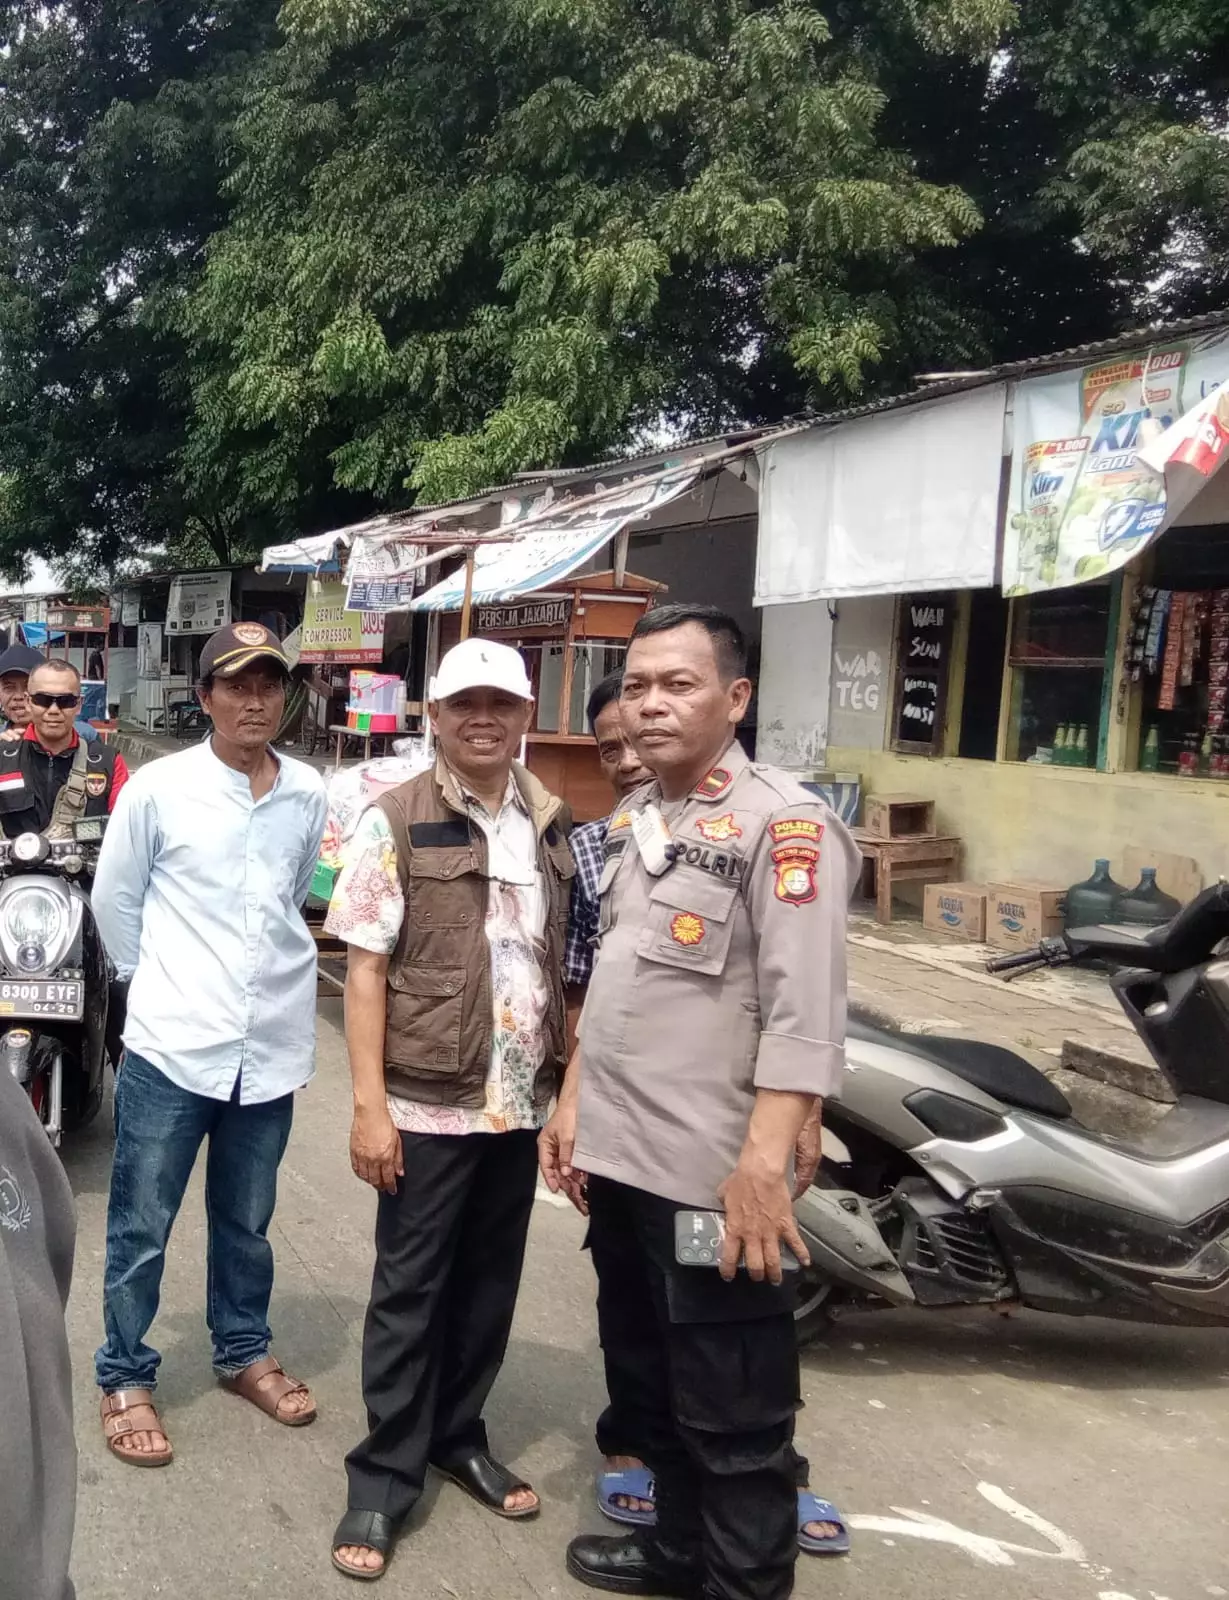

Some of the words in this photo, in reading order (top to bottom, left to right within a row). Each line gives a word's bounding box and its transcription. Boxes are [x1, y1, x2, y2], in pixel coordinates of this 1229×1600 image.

[315, 606, 344, 623] SERVICE
[478, 609, 518, 627] PERSIJA
[520, 602, 565, 624] JAKARTA
[304, 627, 353, 643] COMPRESSOR
[834, 650, 882, 679] WAR
[774, 820, 818, 833] POLSEK
[937, 896, 965, 914] AQUA
[996, 901, 1026, 920] AQUA
[46, 985, 76, 1000] EYF
